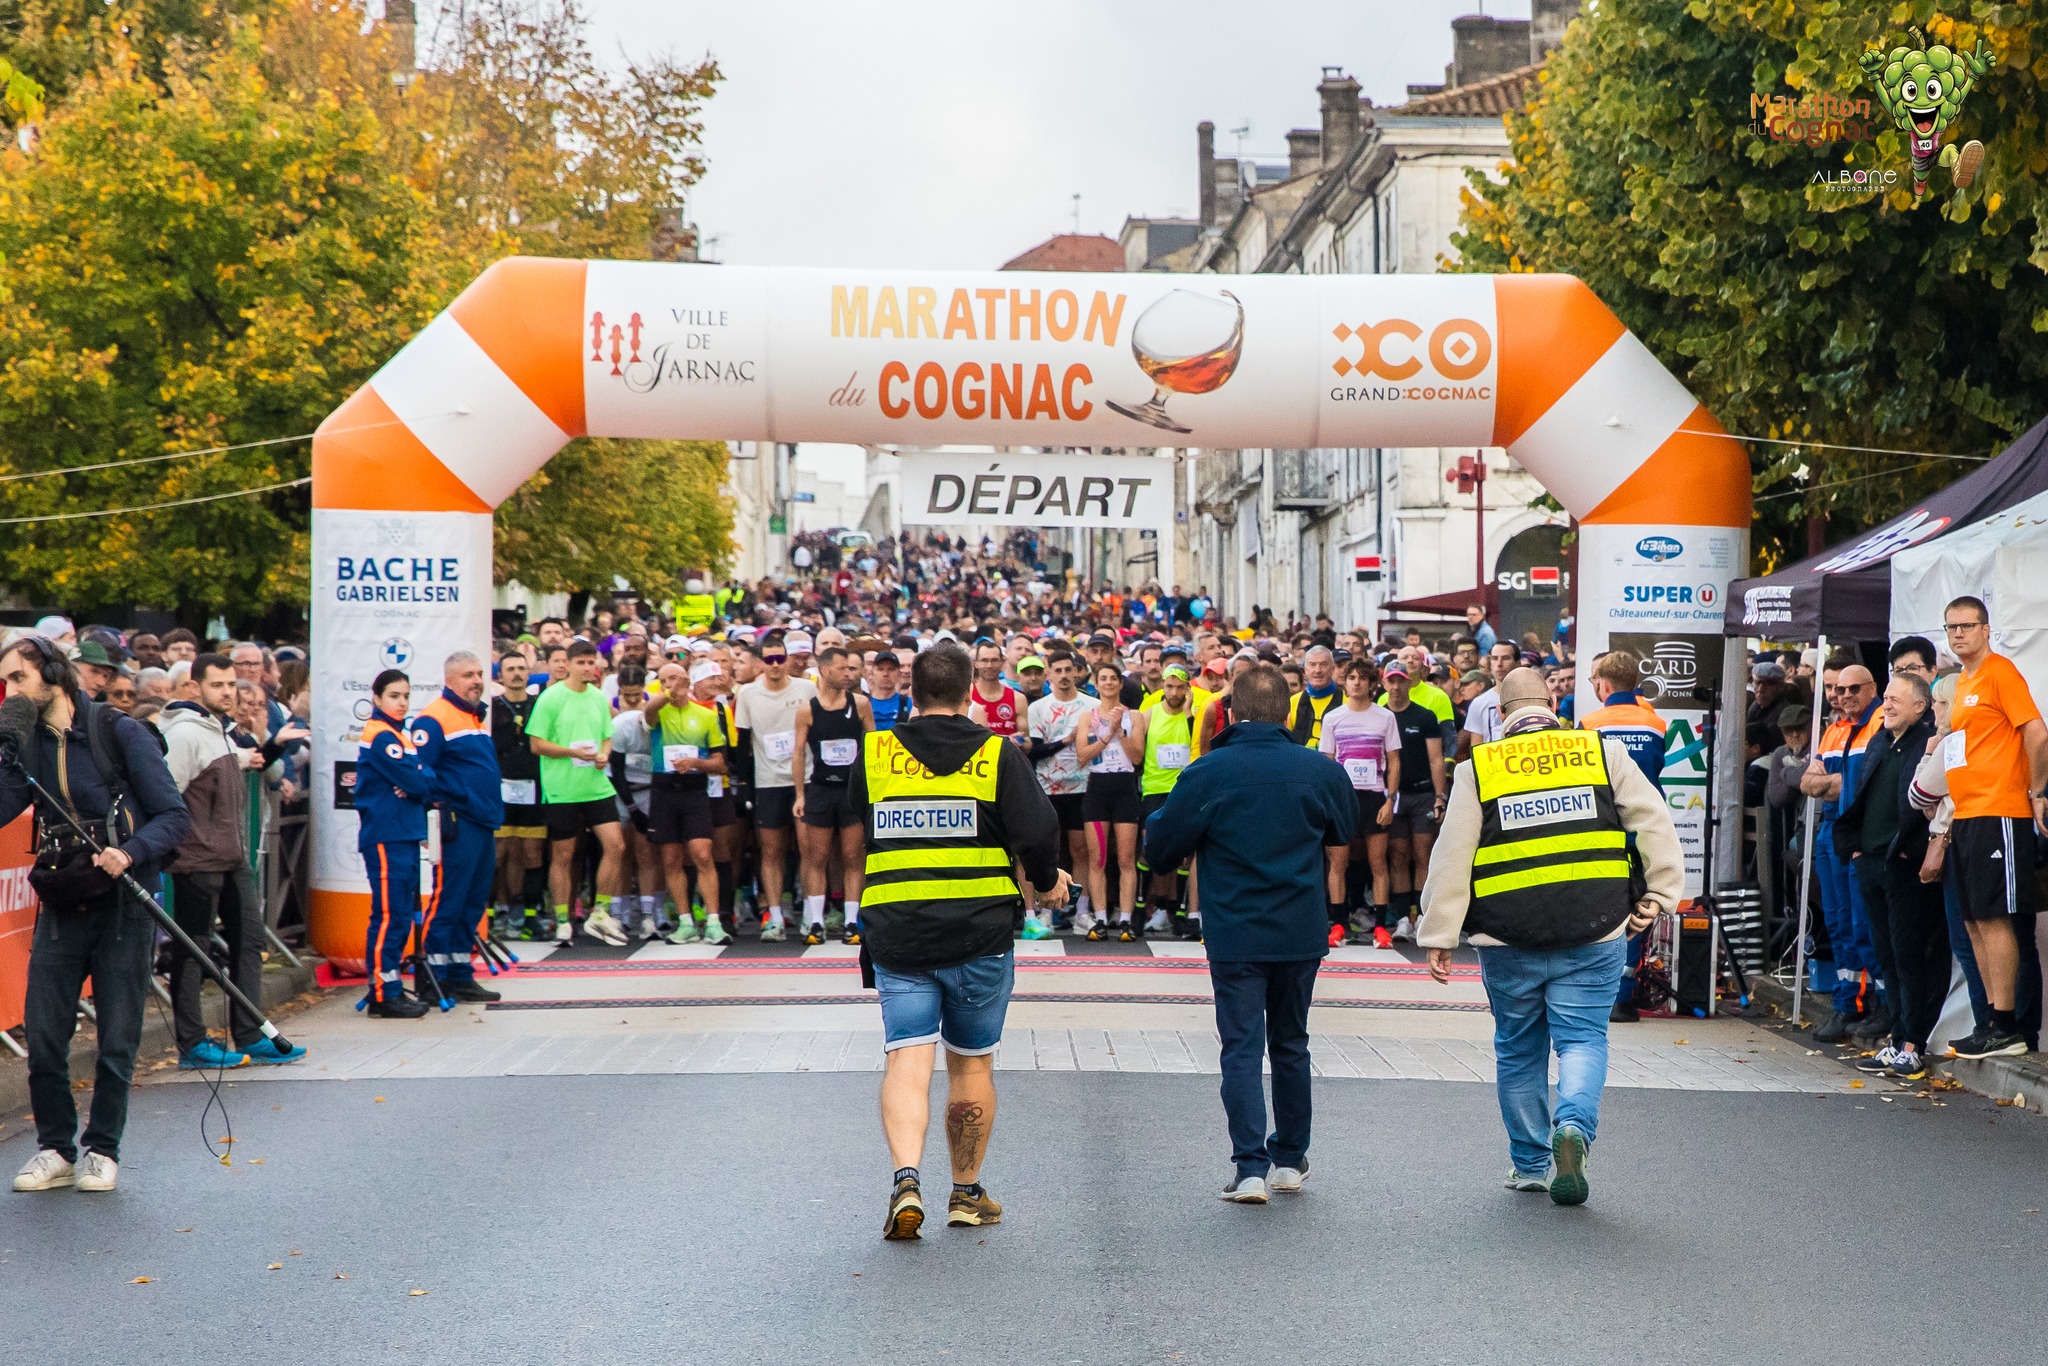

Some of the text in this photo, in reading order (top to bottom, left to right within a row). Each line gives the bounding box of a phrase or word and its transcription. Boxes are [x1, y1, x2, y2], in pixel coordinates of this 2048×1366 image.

[671, 308, 728, 327] VILLE
[831, 285, 1127, 347] MARATHON
[686, 333, 712, 350] DE
[623, 341, 755, 394] JARNAC
[828, 361, 1094, 422] du COGNAC
[927, 463, 1152, 518] DÉPART
[337, 557, 459, 582] BACHE
[1498, 572, 1527, 590] SG
[336, 585, 459, 602] GABRIELSEN
[1624, 585, 1713, 603] SUPER U
[1486, 734, 1588, 762] Marathon
[891, 752, 989, 780] Cogac
[1505, 751, 1596, 776] Cognac
[877, 809, 972, 829] DIRECTEUR
[1502, 793, 1592, 821] PRESIDENT
